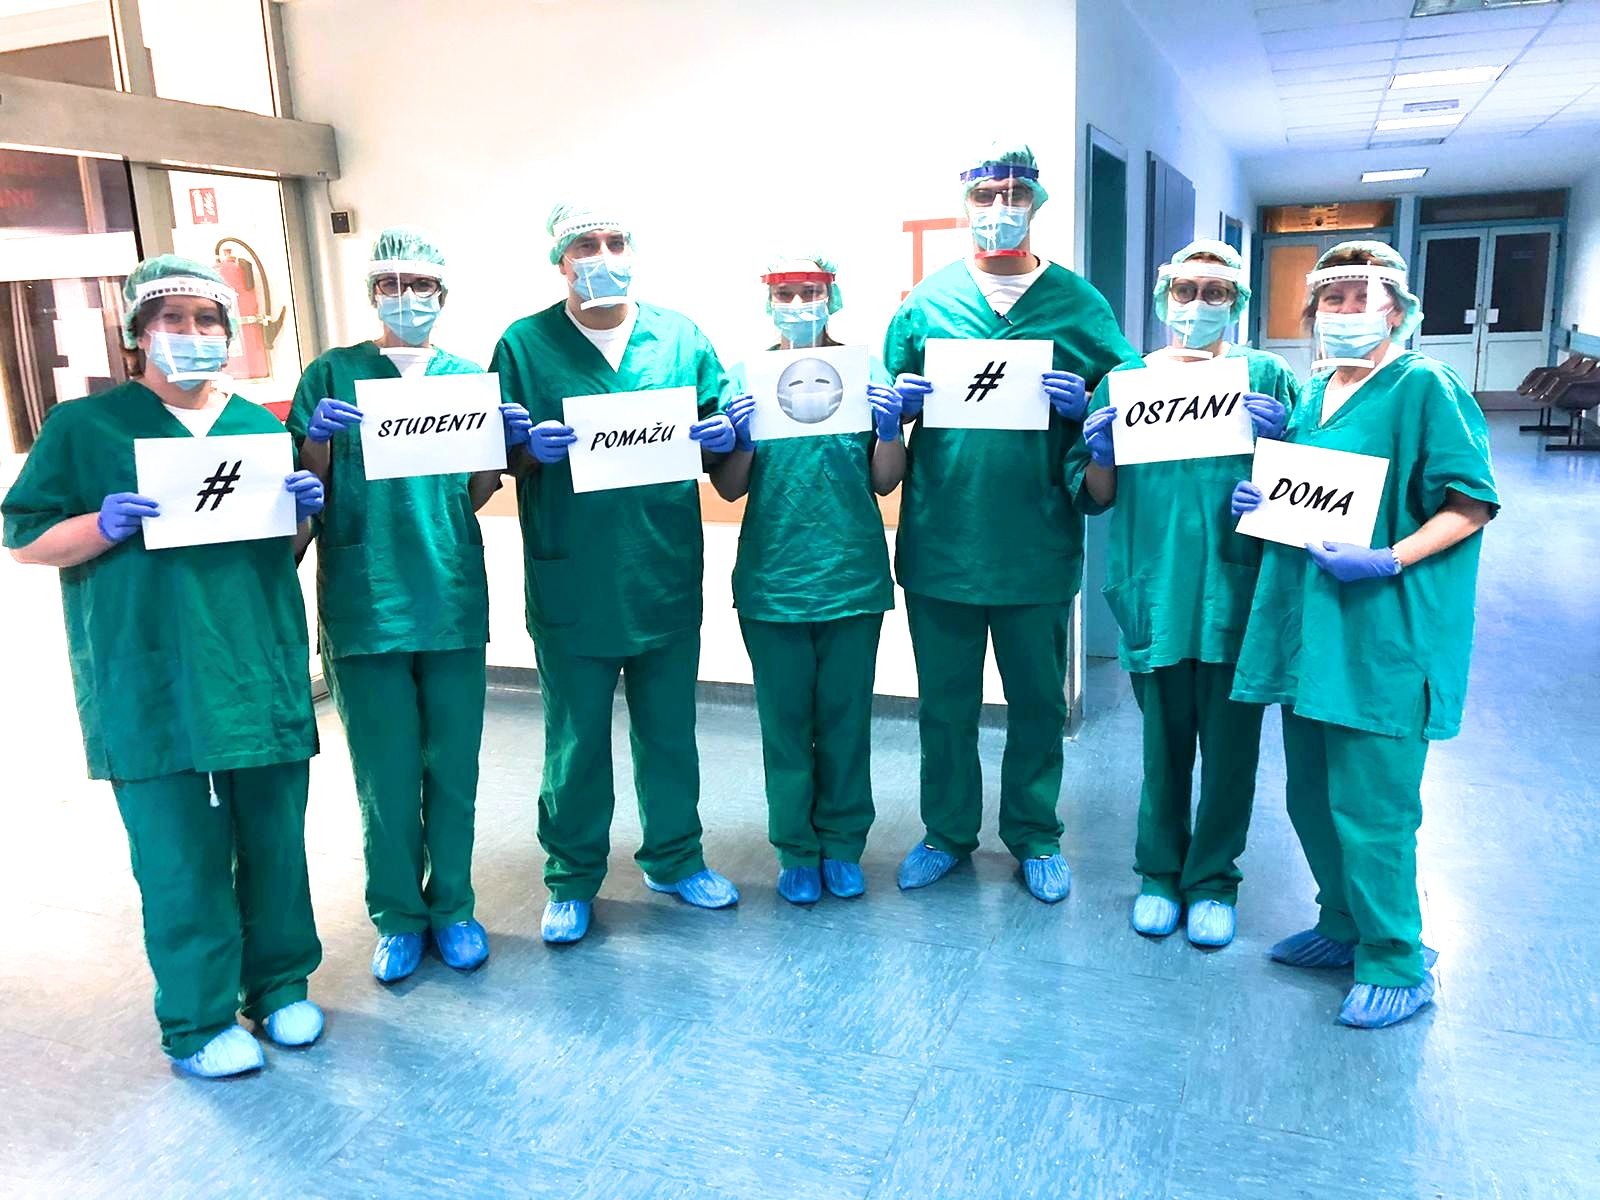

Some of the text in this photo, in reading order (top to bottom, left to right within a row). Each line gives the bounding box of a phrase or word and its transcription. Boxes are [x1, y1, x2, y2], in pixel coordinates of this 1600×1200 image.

[965, 361, 1007, 402] #
[377, 412, 487, 438] STUDENTI
[1125, 391, 1242, 428] OSTANI
[590, 422, 676, 452] POMAŽU
[195, 460, 242, 512] #
[1268, 477, 1355, 516] DOMA
